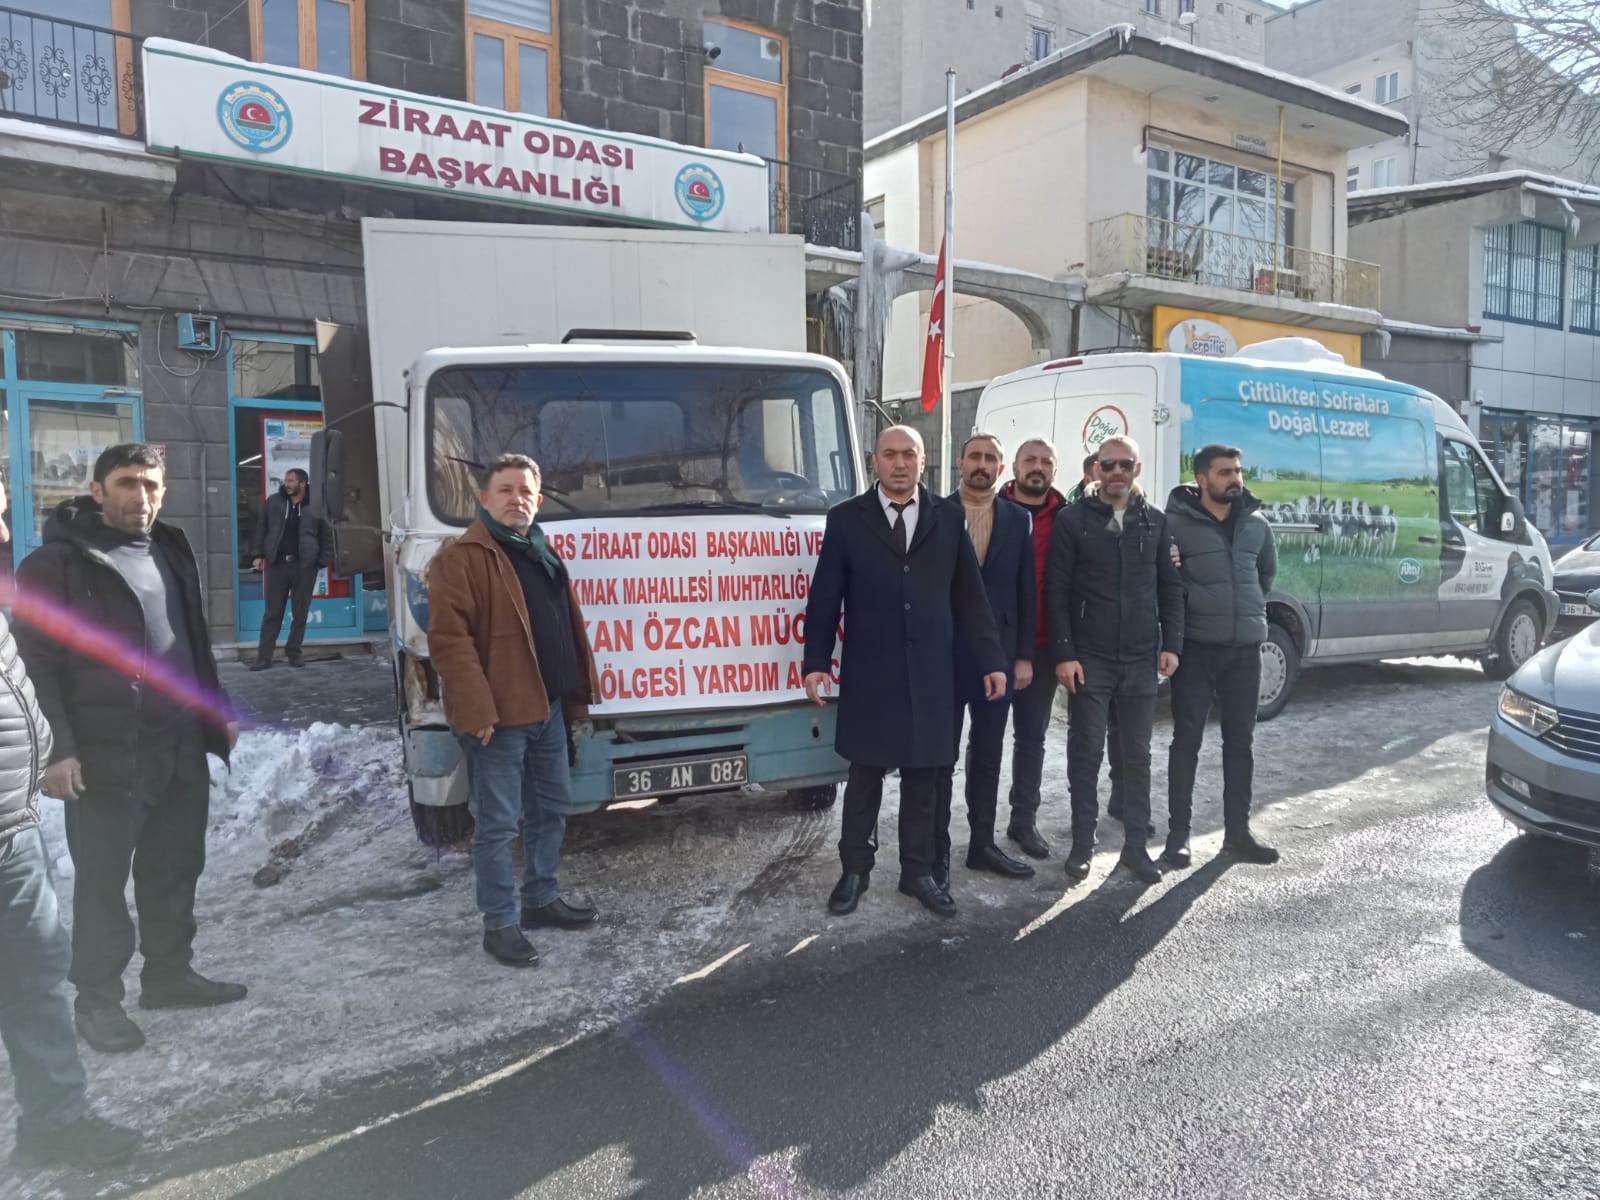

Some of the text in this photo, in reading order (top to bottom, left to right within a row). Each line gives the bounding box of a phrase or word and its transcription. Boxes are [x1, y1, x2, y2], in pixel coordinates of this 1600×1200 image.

[358, 98, 634, 170] ZİRAAT ODASI
[378, 146, 621, 207] BAŞKANLIĞI
[1238, 380, 1390, 415] Çiftlikten Sofralara
[1268, 409, 1371, 438] Doğal Lezzet
[581, 526, 642, 559] ZİRAAT
[647, 532, 696, 559] ODASI
[707, 526, 801, 564] BAŞKANLIĞI
[806, 531, 823, 556] VE
[570, 578, 619, 606] KMAK
[623, 569, 713, 604] MAHALLESİ
[583, 619, 634, 652] AN
[643, 611, 742, 651] ÖZCAN
[600, 659, 686, 700] ÖLGESİ
[693, 662, 779, 695] YARDIM
[628, 759, 744, 793] 36 AN 082
